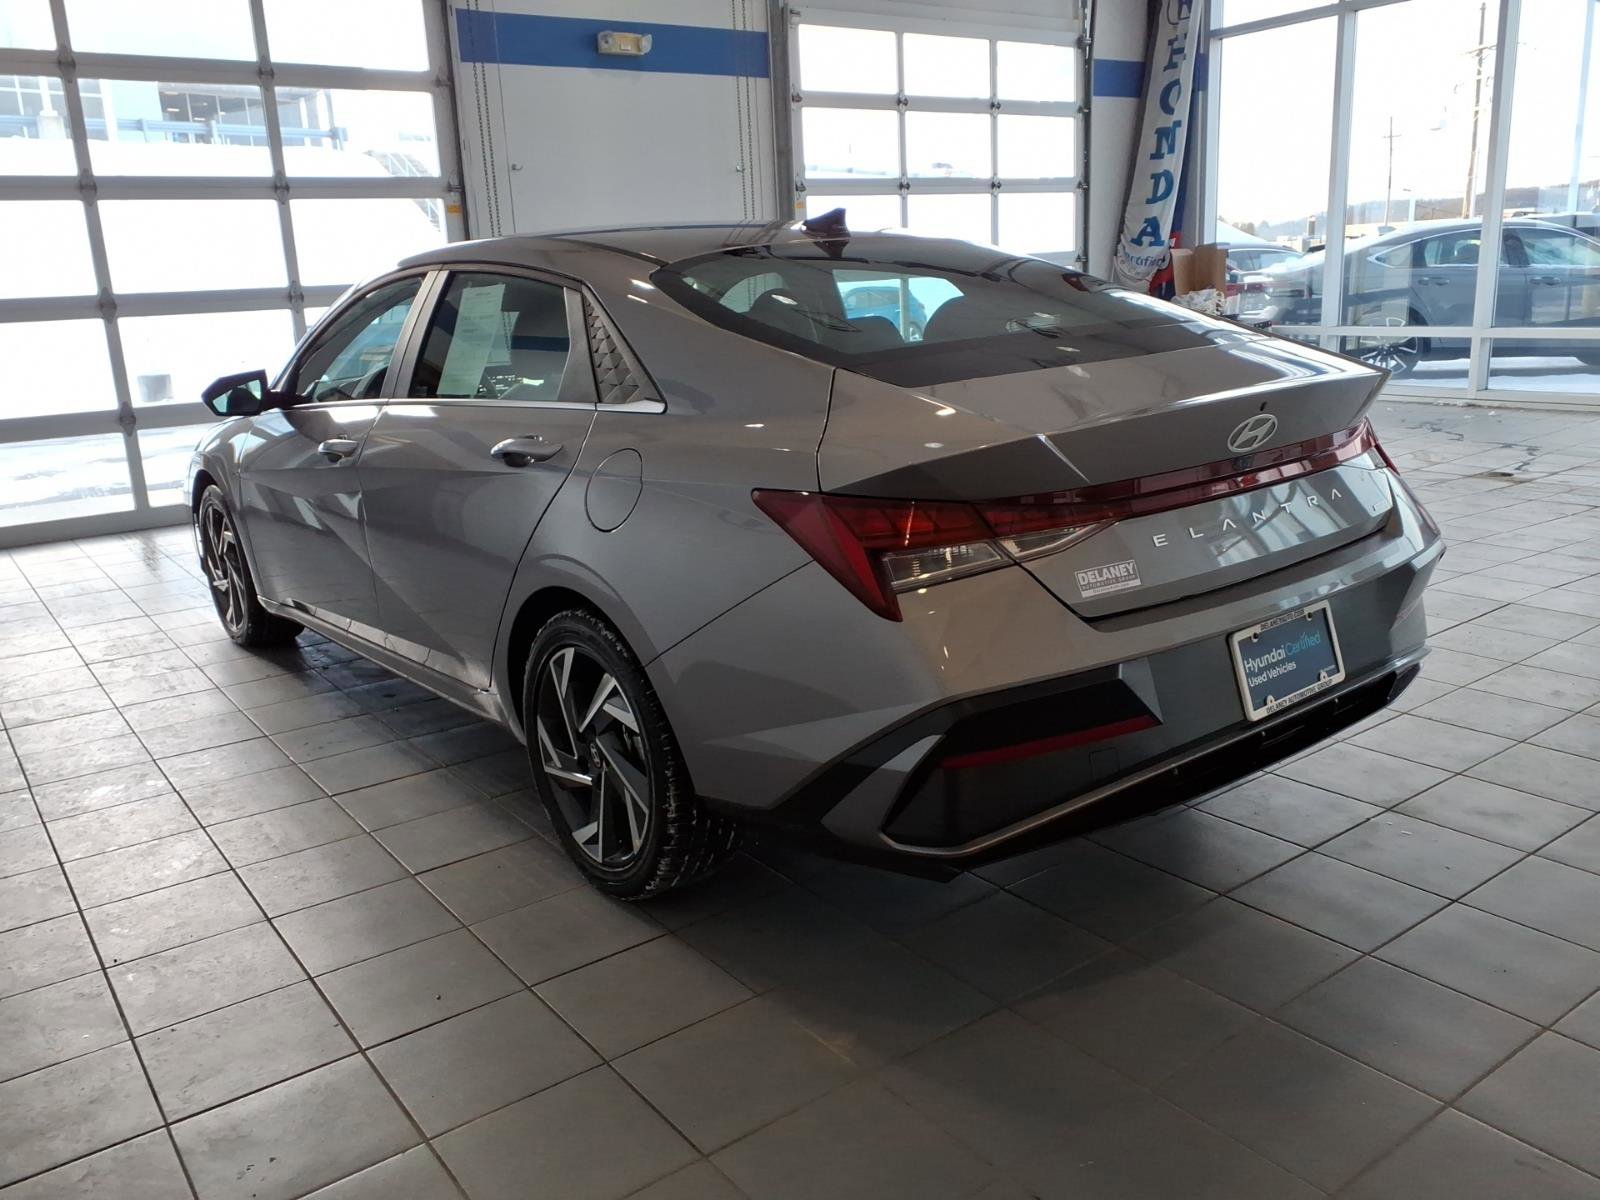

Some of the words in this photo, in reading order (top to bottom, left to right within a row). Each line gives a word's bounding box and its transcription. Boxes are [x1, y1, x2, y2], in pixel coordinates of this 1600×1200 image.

[1130, 32, 1187, 248] HONDA
[1152, 488, 1342, 547] ELANTRA
[1077, 562, 1135, 586] DELANEY
[1248, 671, 1267, 688] Used
[1267, 661, 1297, 680] Vehicles
